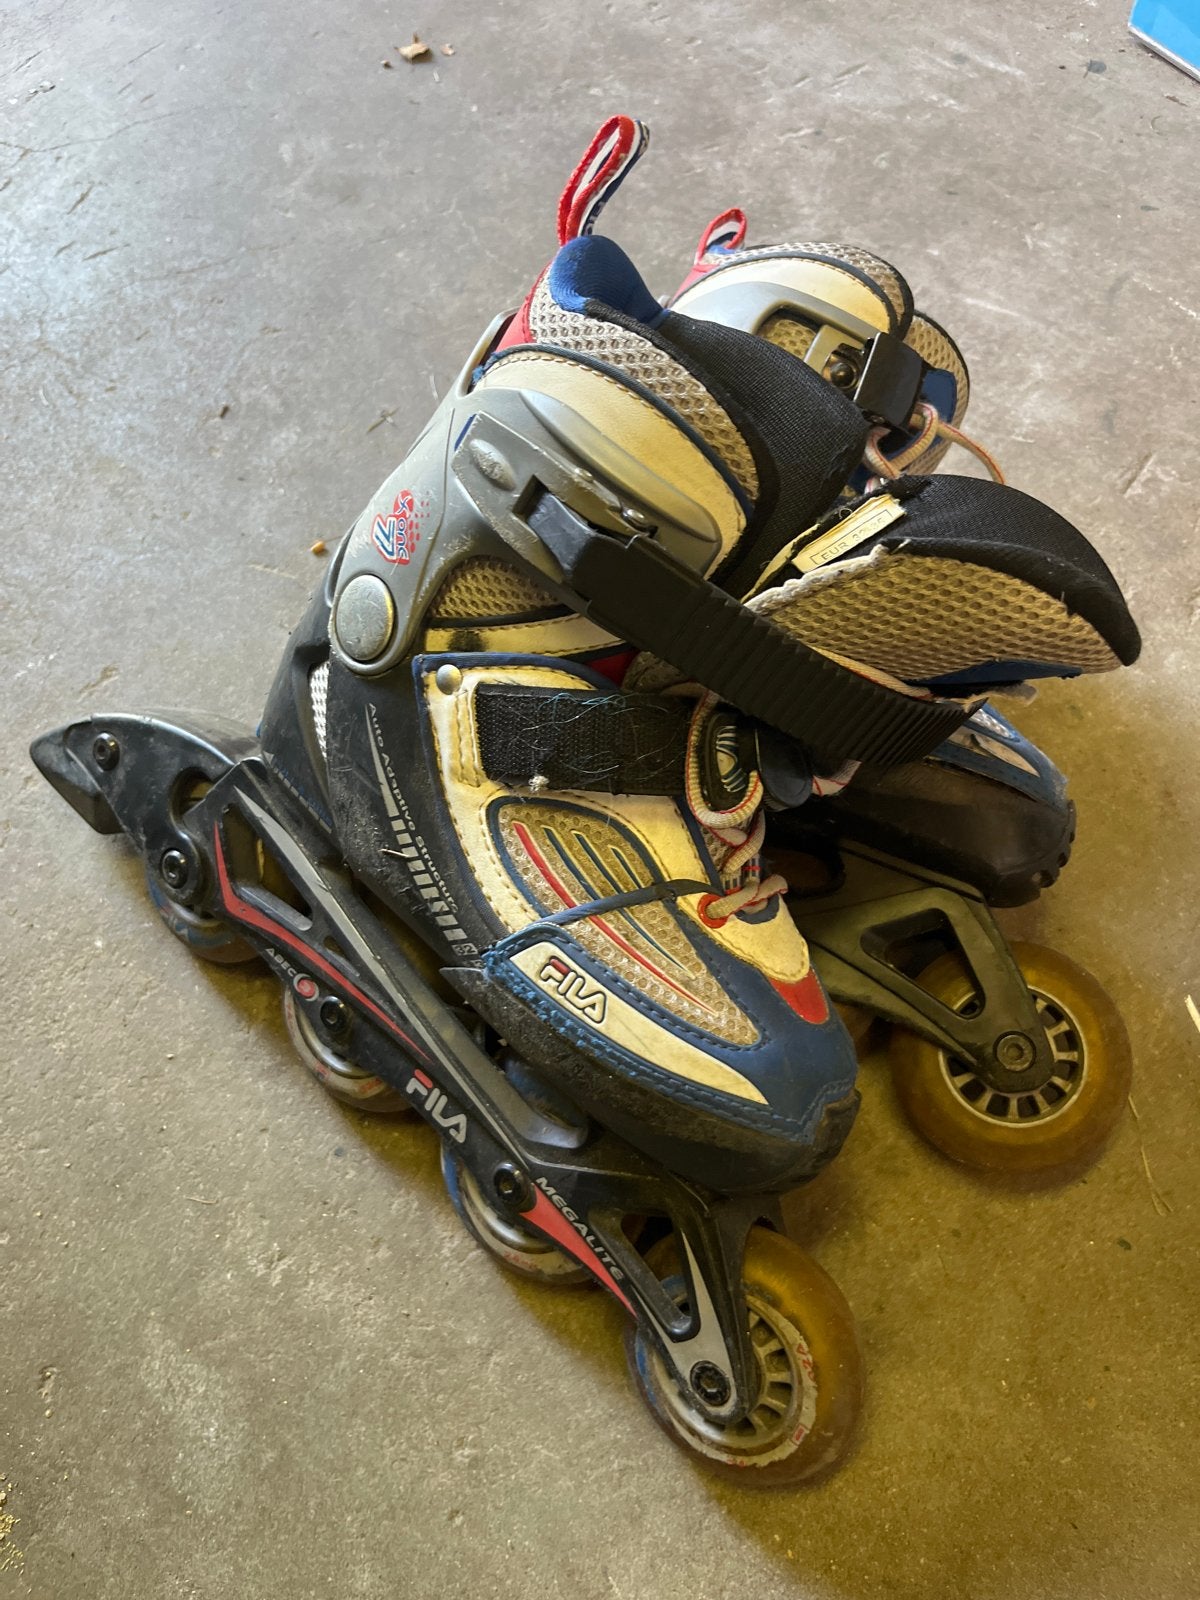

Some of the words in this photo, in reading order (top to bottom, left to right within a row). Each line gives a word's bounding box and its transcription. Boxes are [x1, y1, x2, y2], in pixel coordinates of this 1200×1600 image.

[821, 541, 851, 561] EUR
[368, 702, 385, 748] Auto
[381, 752, 416, 831] Adaptive
[415, 835, 459, 914] Structure
[265, 947, 297, 977] ABEC
[540, 956, 607, 1024] FILA
[405, 1068, 467, 1144] FILA
[536, 1176, 624, 1281] MEGALITE
